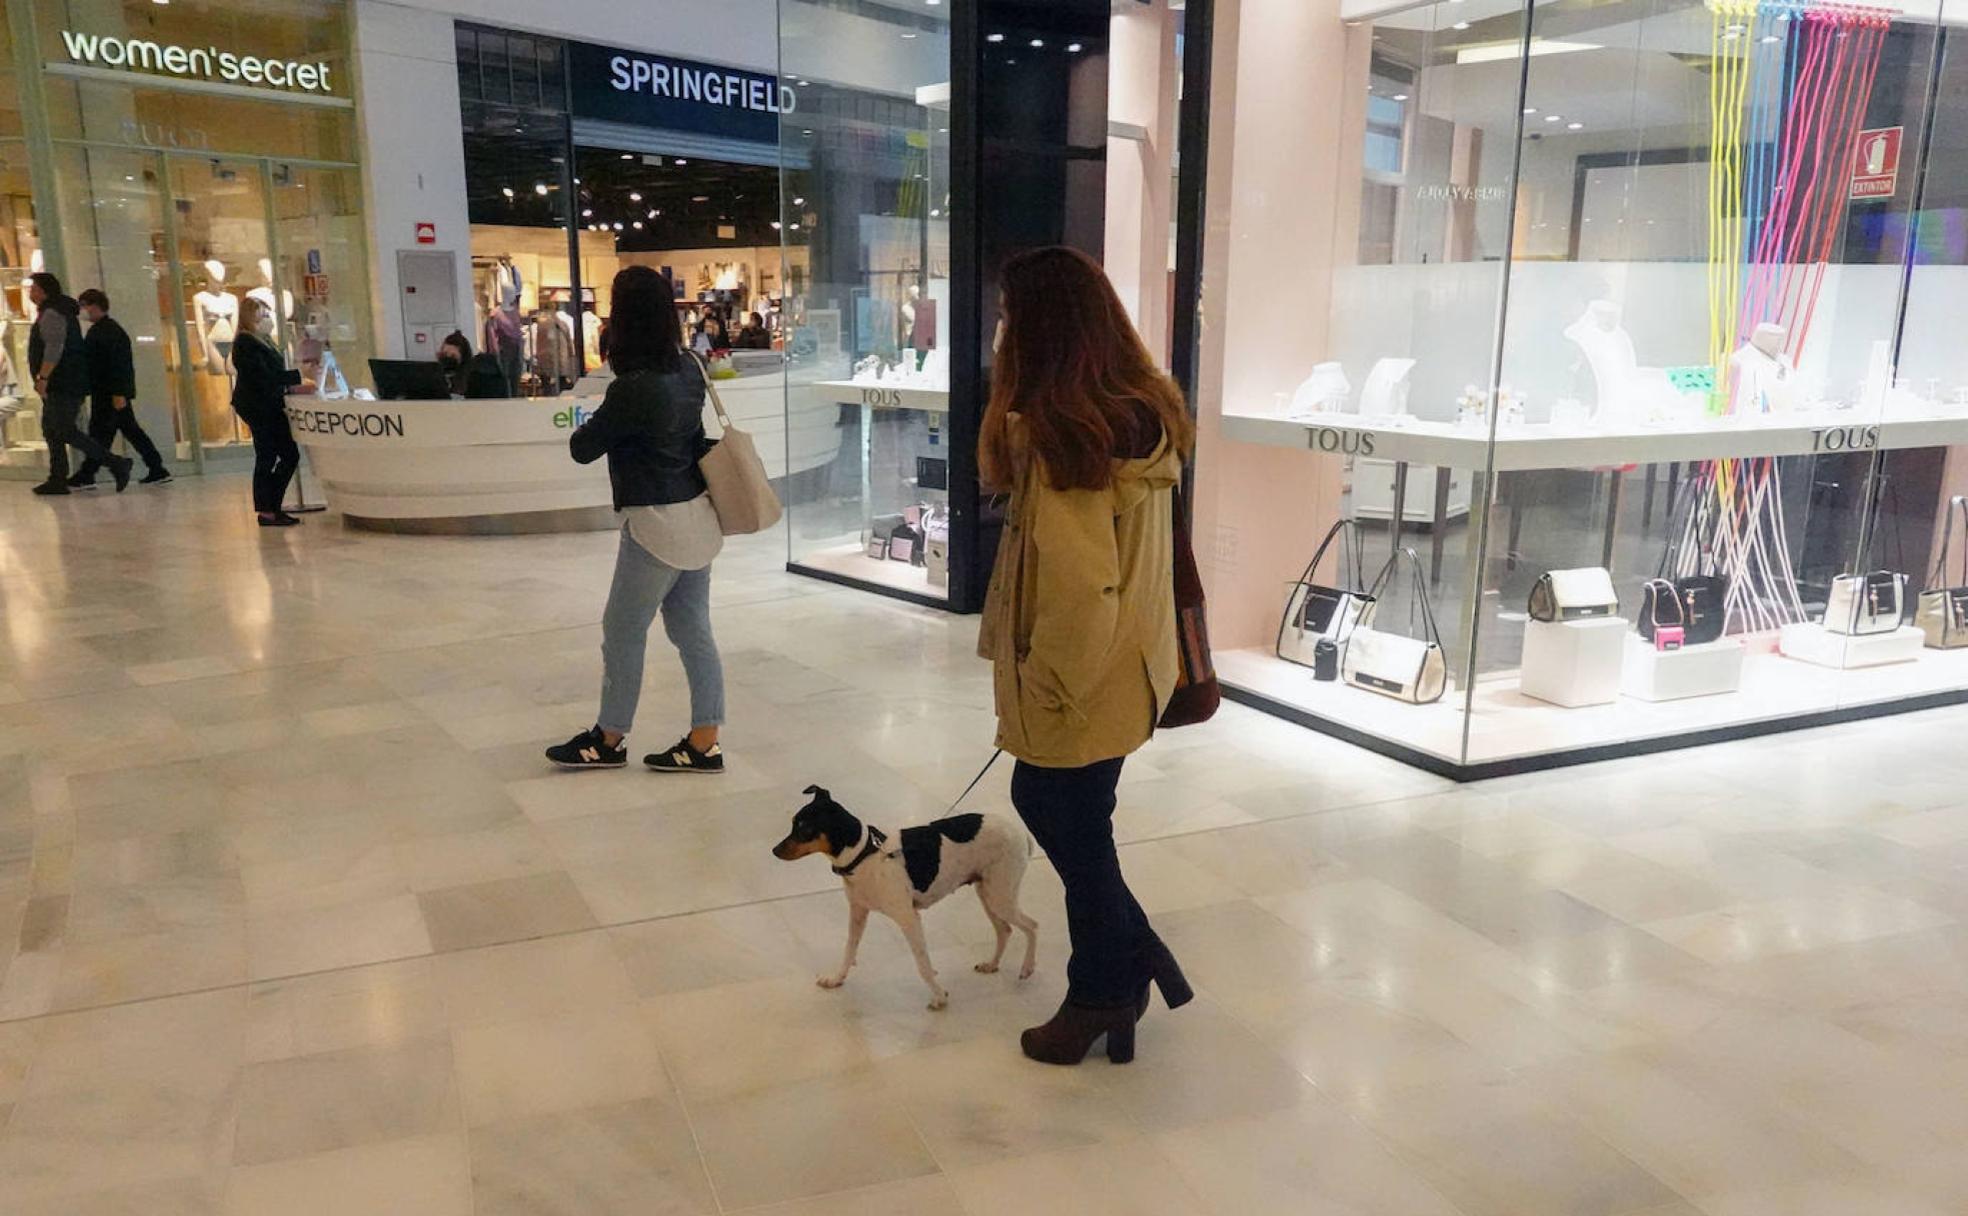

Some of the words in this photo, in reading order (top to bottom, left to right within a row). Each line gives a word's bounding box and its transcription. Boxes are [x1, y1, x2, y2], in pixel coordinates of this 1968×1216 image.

[62, 30, 331, 91] women'secret
[610, 56, 796, 114] SPRINGFIELD
[862, 388, 901, 406] TOUS
[1305, 427, 1374, 456] TOUS
[1811, 426, 1879, 451] TOUS
